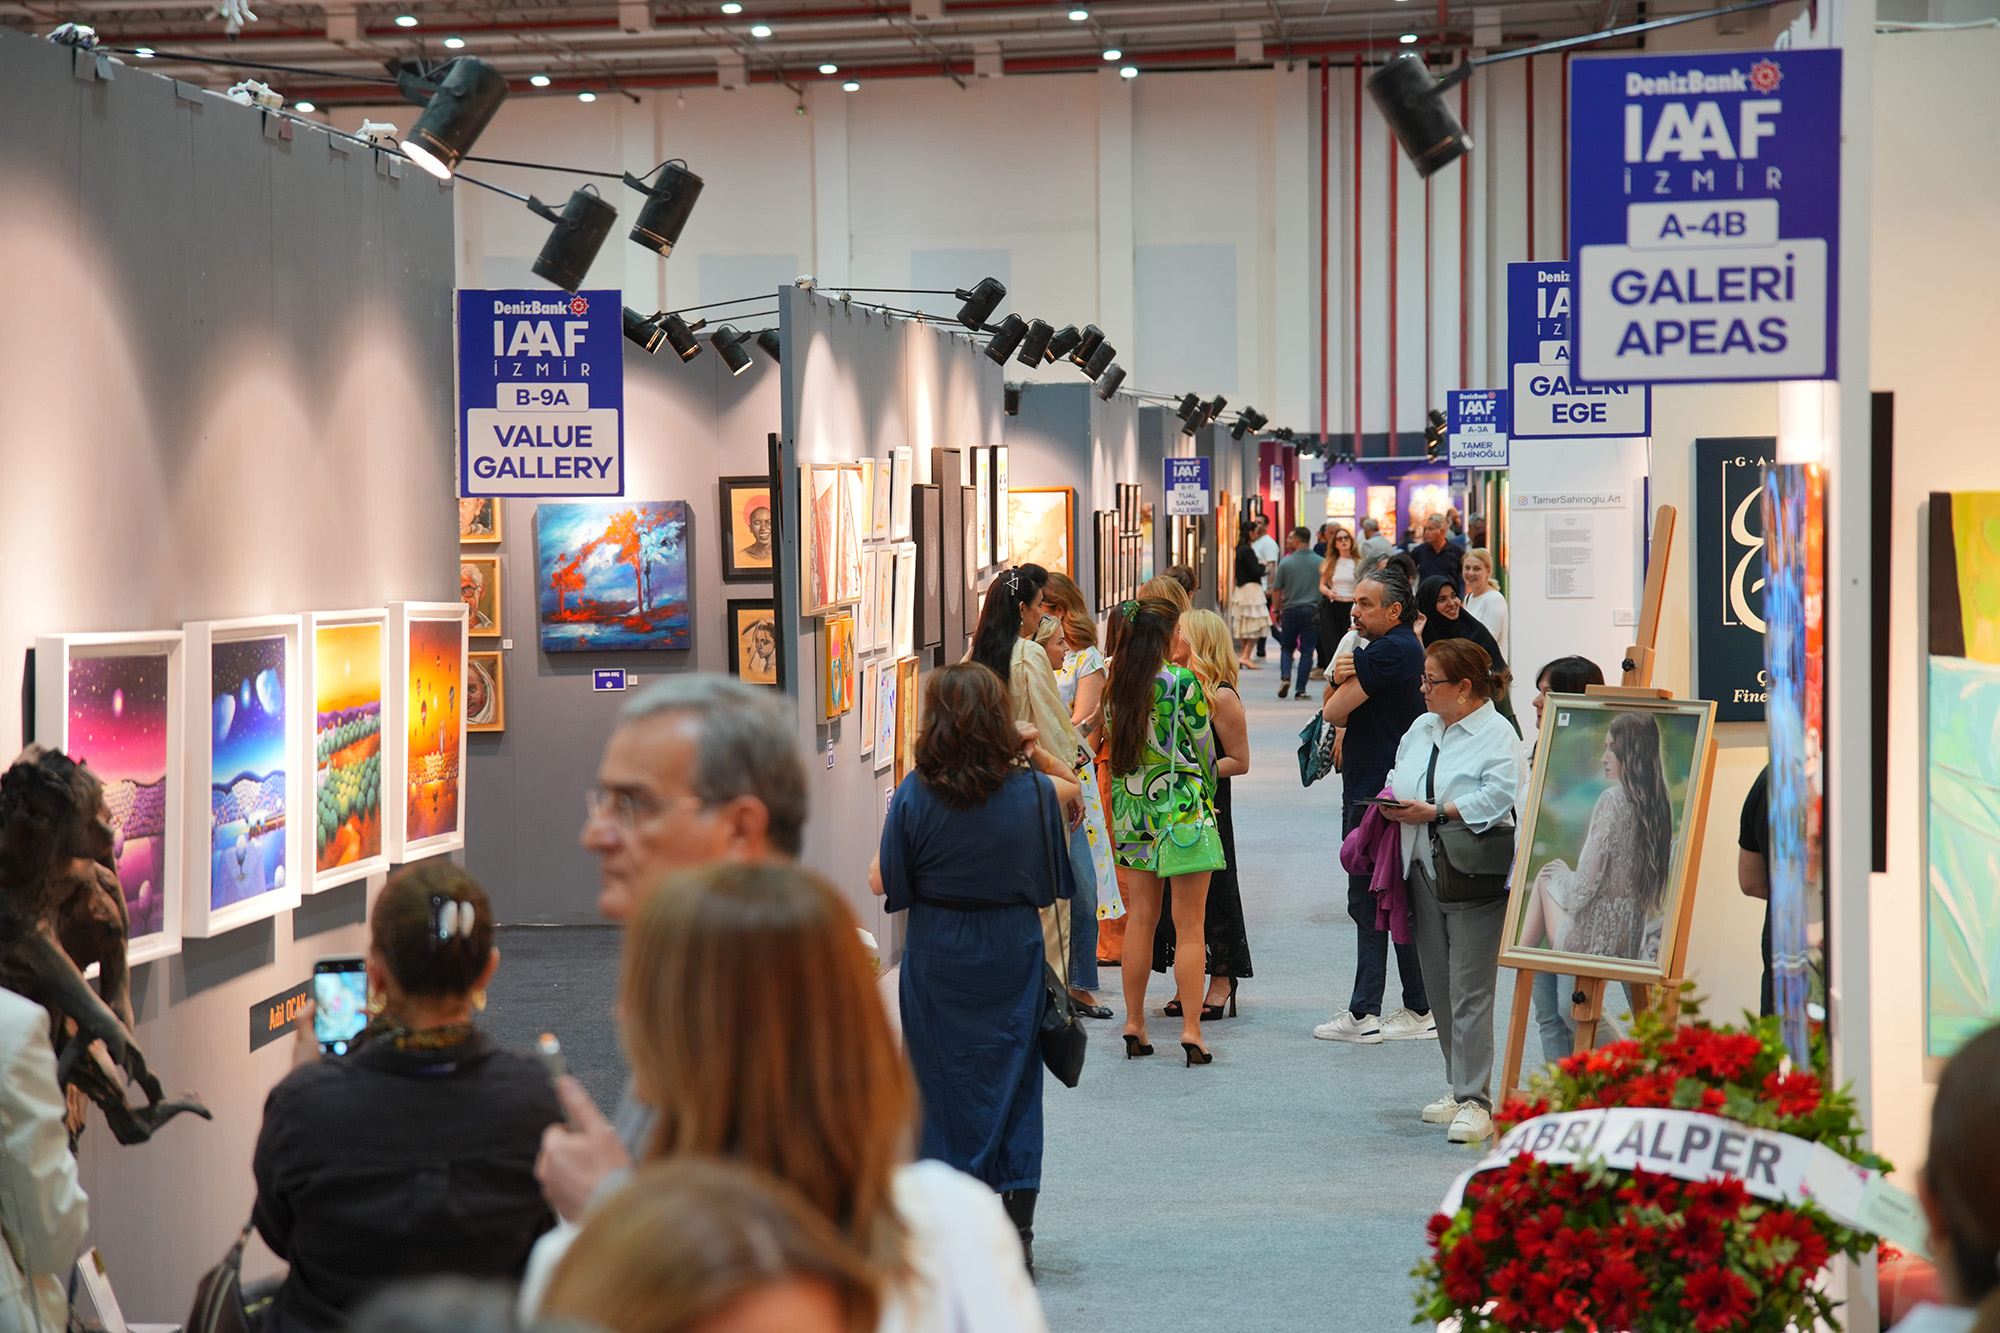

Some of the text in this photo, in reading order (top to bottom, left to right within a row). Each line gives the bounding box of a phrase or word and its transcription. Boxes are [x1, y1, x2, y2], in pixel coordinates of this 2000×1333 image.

[1625, 67, 1748, 96] DenizBank
[1624, 99, 1782, 163] IAAF
[1624, 163, 1782, 195] İZMİR
[1658, 211, 1747, 239] A-4B
[1611, 253, 1795, 305] GALERİ
[494, 300, 568, 315] DenizBank
[493, 320, 589, 357] IAAF
[1615, 317, 1788, 357] APEAS
[494, 360, 590, 377] İZMİR
[516, 388, 570, 406] B-9A
[1459, 400, 1496, 415] IAAF
[1552, 402, 1607, 423] EGE
[493, 425, 593, 448] VALUE
[1452, 448, 1505, 460] ŞAHİNOĞLU
[473, 456, 614, 479] GALLERY
[1173, 465, 1200, 477] IAAF
[1532, 495, 1621, 505] TamerSahinoglu.Art
[1615, 1120, 1783, 1185] ALPER
